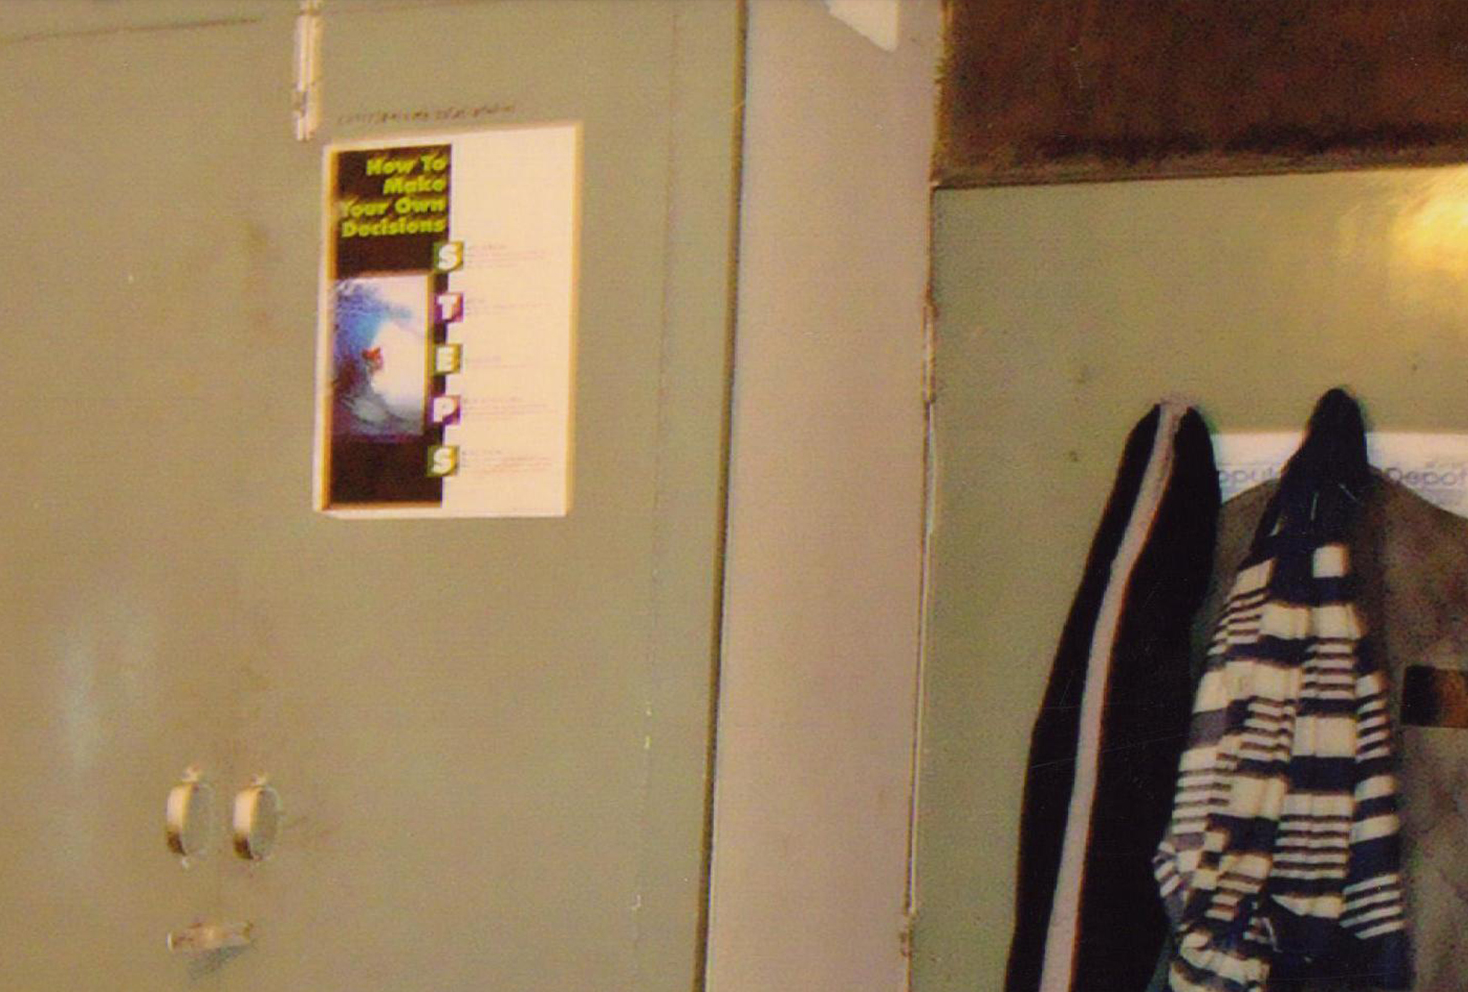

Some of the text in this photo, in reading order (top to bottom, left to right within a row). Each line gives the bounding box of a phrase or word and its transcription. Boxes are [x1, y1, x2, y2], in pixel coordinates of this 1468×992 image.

[366, 153, 449, 176] How To
[383, 175, 448, 195] Make
[338, 197, 448, 218] Your Own
[341, 217, 448, 237] Decisions
